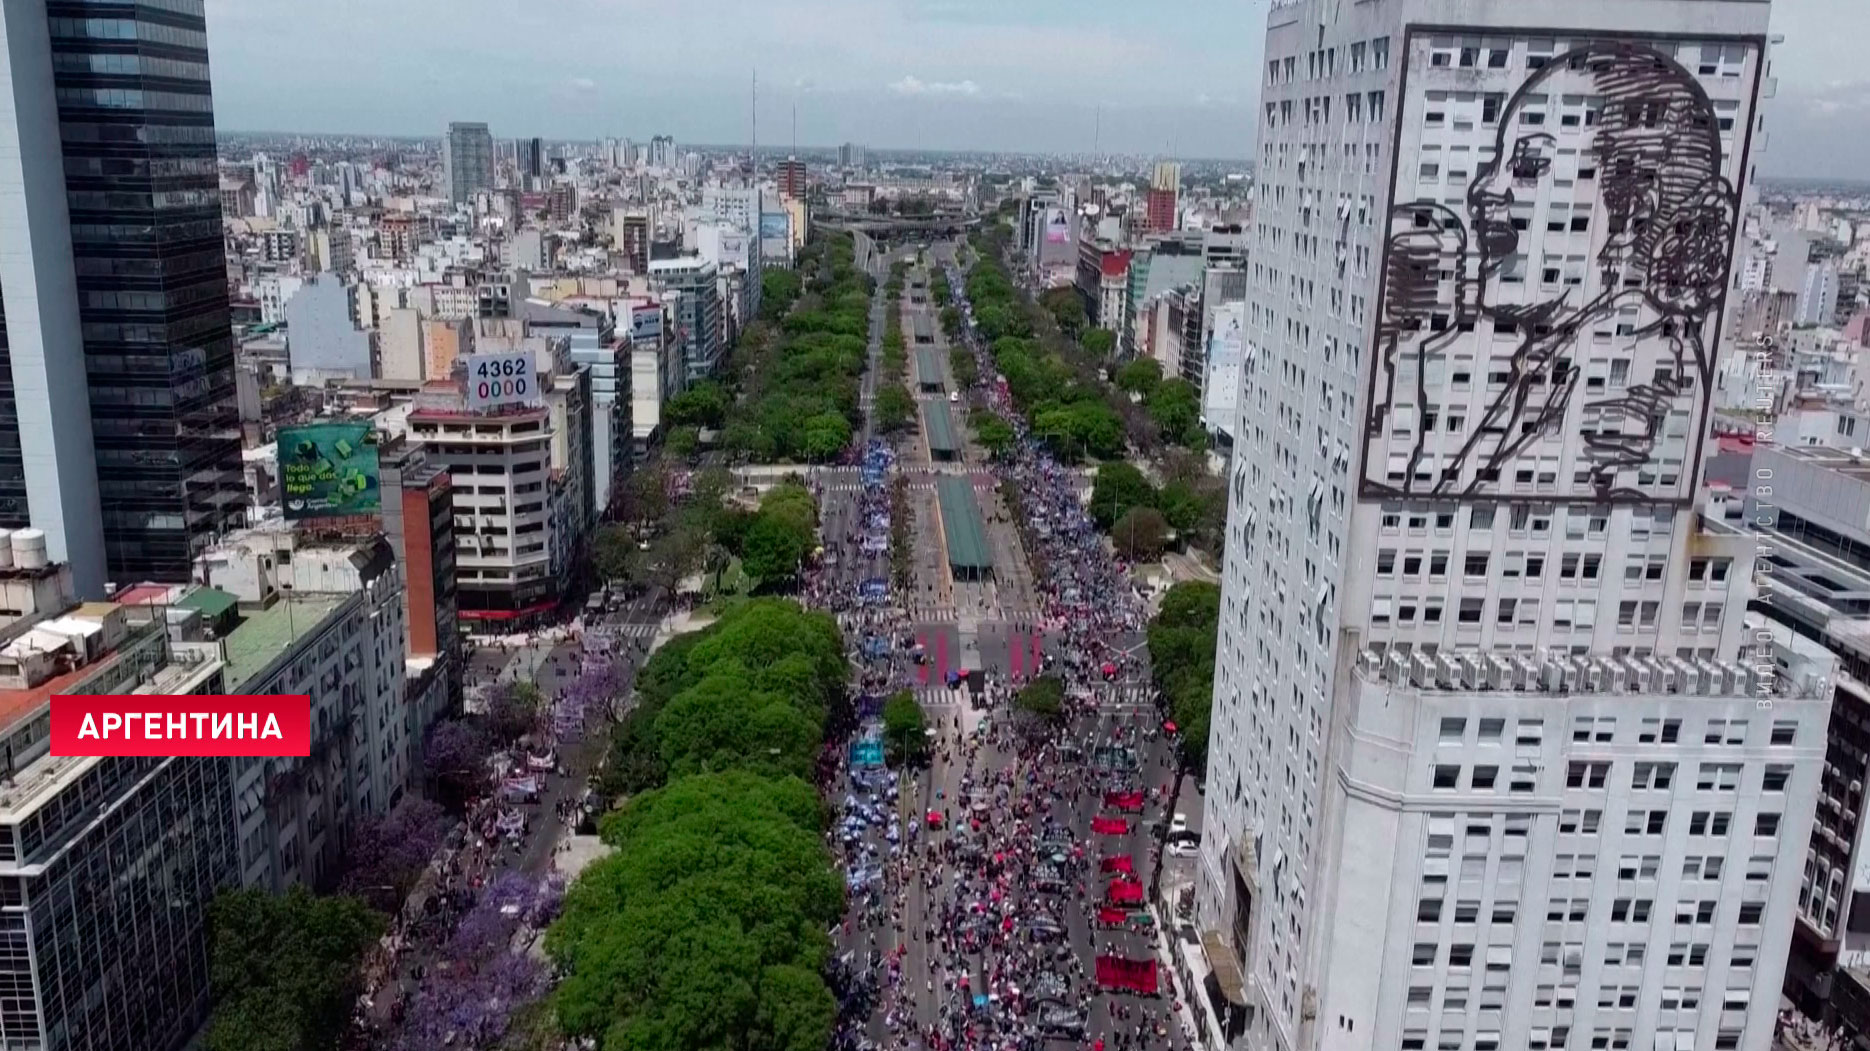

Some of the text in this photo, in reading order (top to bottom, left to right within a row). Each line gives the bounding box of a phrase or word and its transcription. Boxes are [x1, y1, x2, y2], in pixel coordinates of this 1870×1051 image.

[477, 358, 526, 379] 4362
[478, 378, 527, 400] 0000
[285, 464, 310, 473] Todo
[297, 474, 317, 483] que
